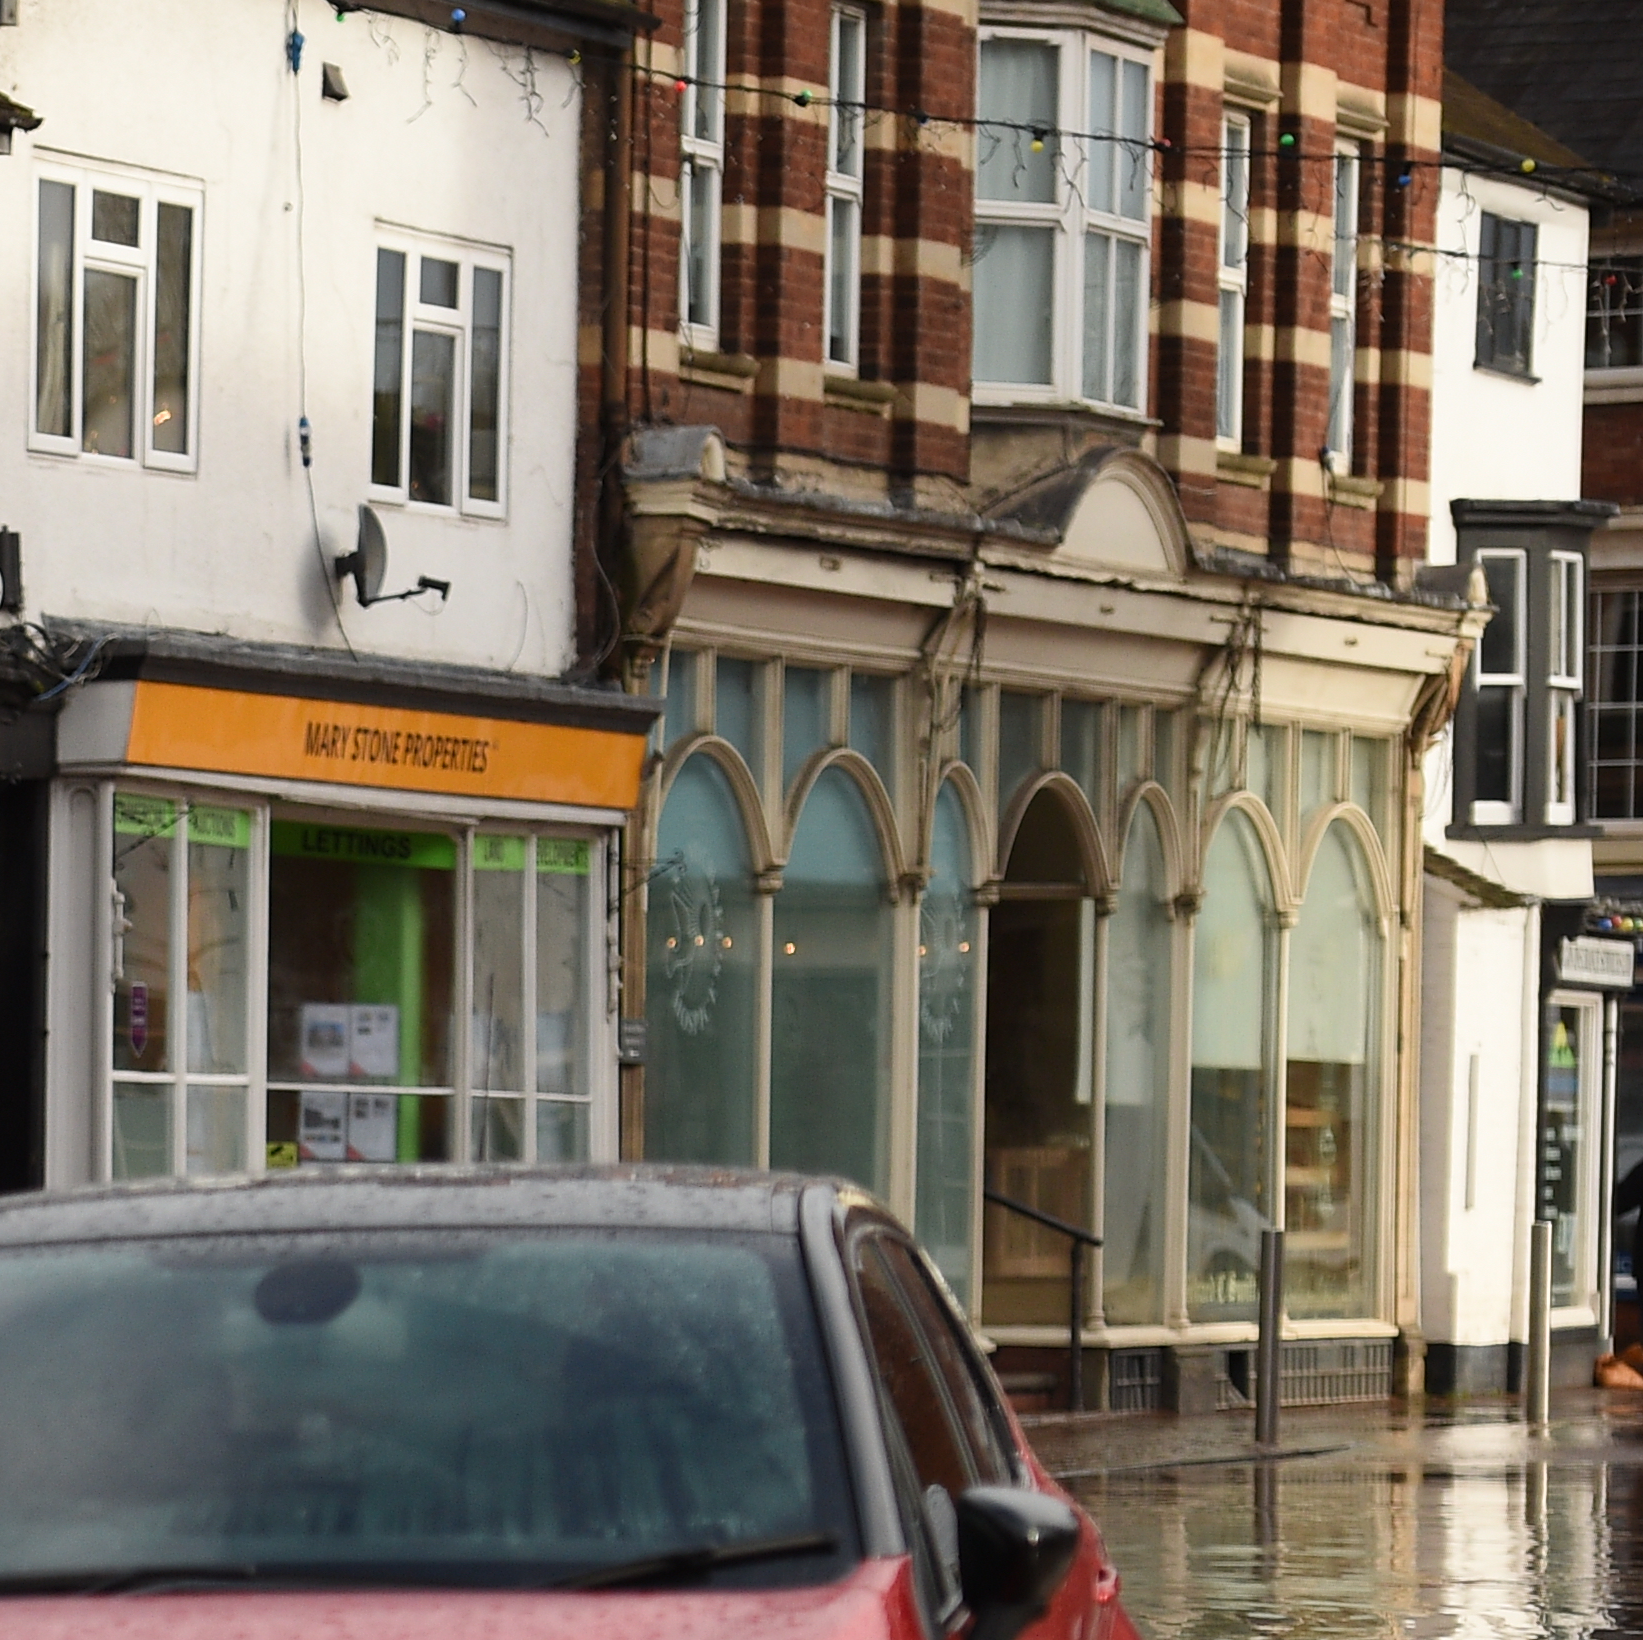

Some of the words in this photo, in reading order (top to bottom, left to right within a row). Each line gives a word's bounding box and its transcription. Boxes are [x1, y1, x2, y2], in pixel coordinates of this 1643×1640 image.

[305, 720, 351, 760] MARY
[351, 726, 403, 765] STONE
[402, 731, 491, 774] PROPERTIES
[302, 829, 413, 860] LETTINGS
